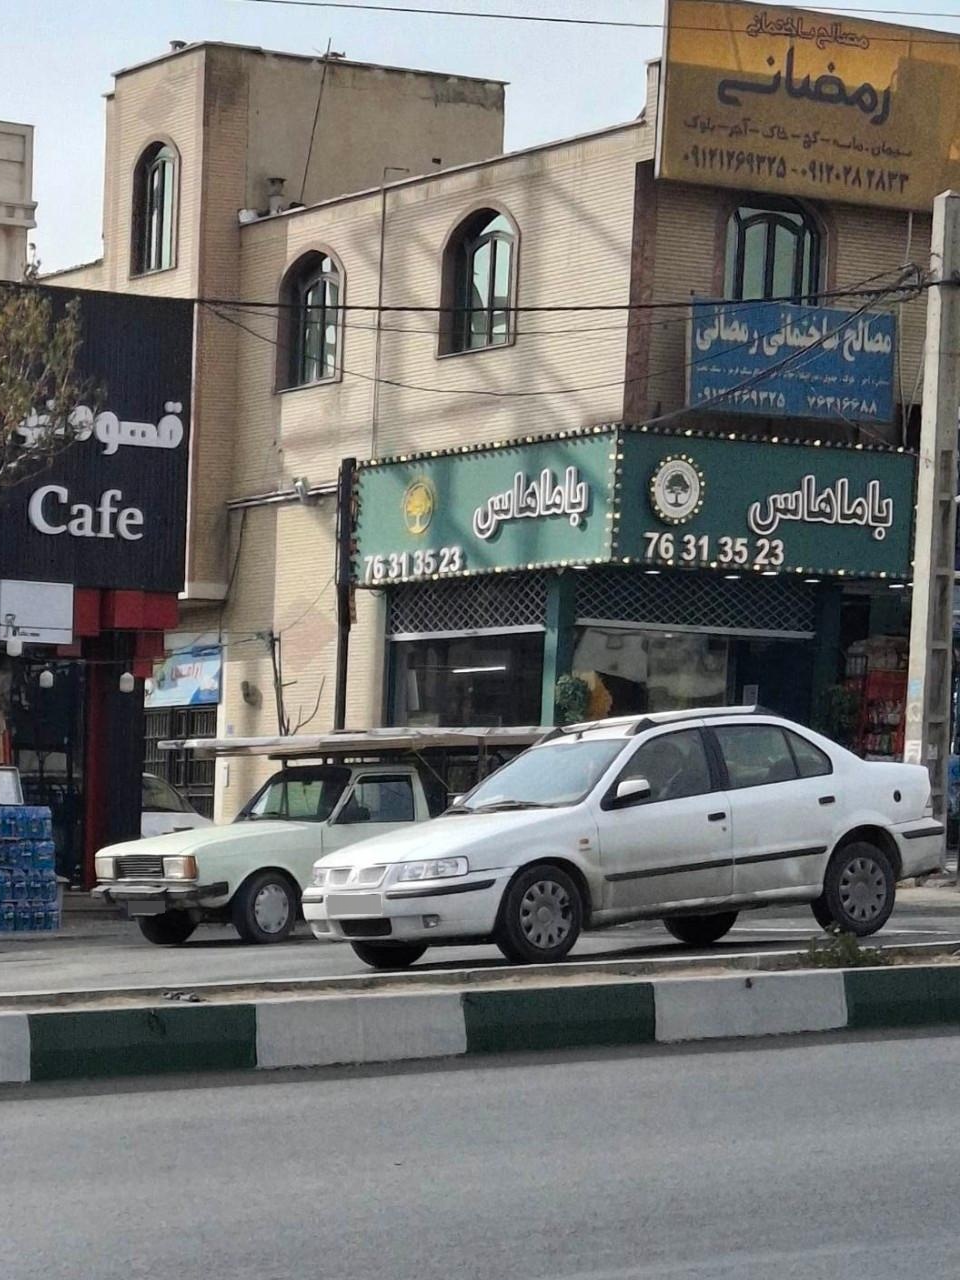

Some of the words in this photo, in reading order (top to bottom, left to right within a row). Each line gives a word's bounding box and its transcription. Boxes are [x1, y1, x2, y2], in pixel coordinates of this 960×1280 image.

[816, 21, 870, 50] مصالح
[718, 45, 892, 126] رمضانی
[27, 484, 145, 541] Cafe
[363, 553, 386, 579] 76
[387, 550, 410, 578] 31
[412, 548, 437, 576] 35
[438, 546, 463, 573] 23
[643, 531, 675, 561] 76
[681, 533, 711, 563] 31
[716, 536, 749, 565] 35
[753, 537, 786, 567] 23
